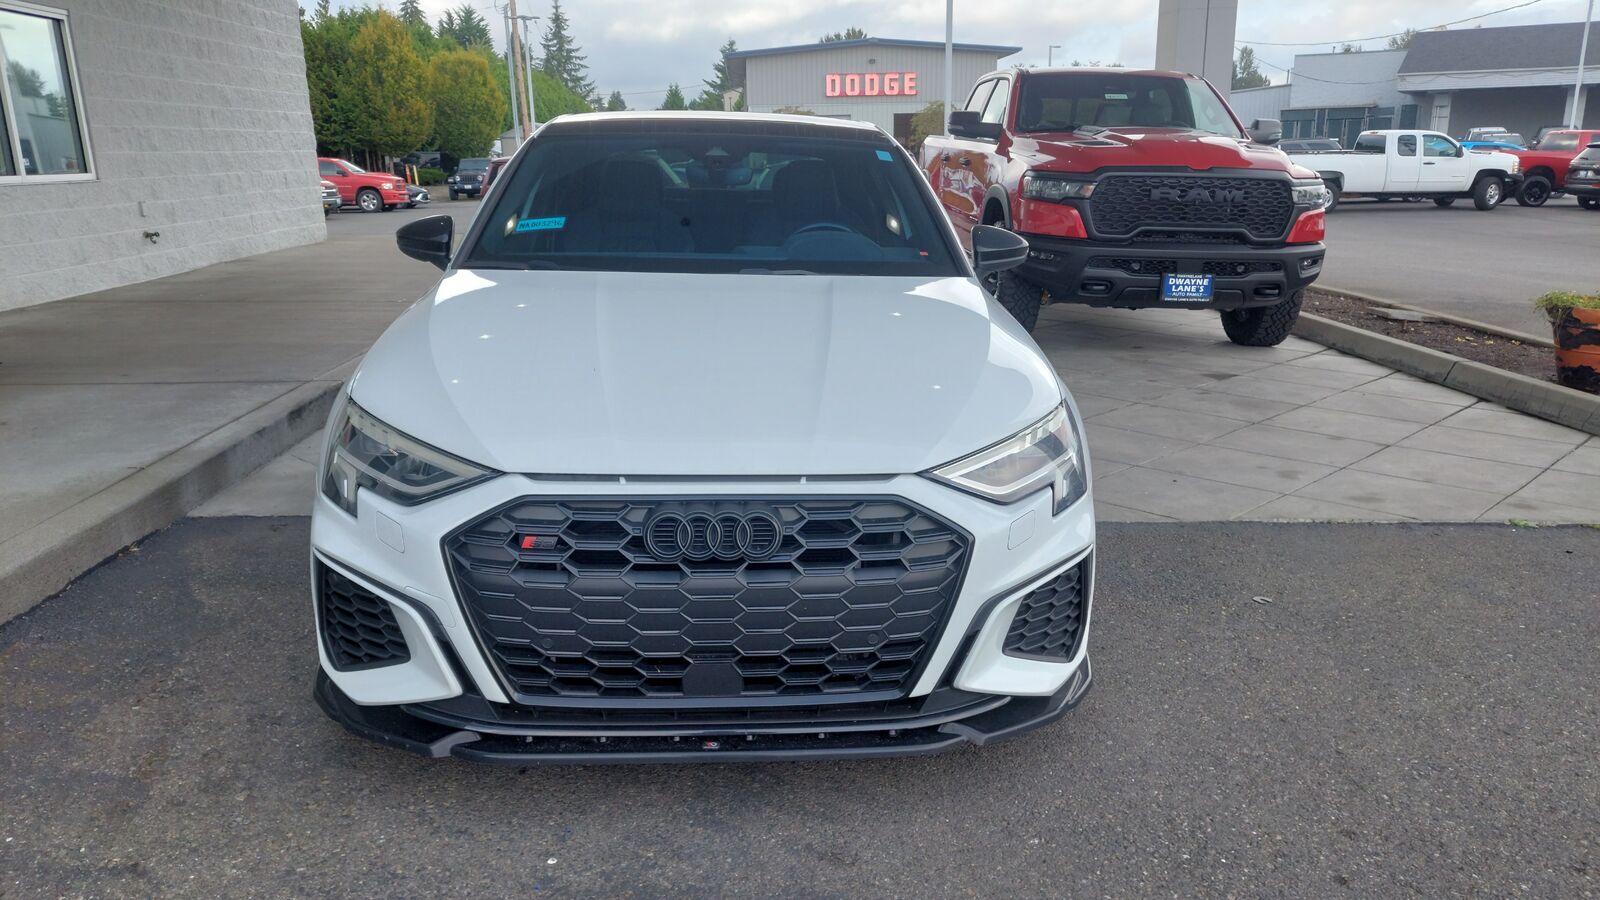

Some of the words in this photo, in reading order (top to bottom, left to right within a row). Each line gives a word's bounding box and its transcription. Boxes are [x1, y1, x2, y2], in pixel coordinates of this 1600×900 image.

[825, 72, 917, 97] DODGE
[1150, 187, 1245, 203] RAM
[1169, 278, 1208, 286] DWAYNE
